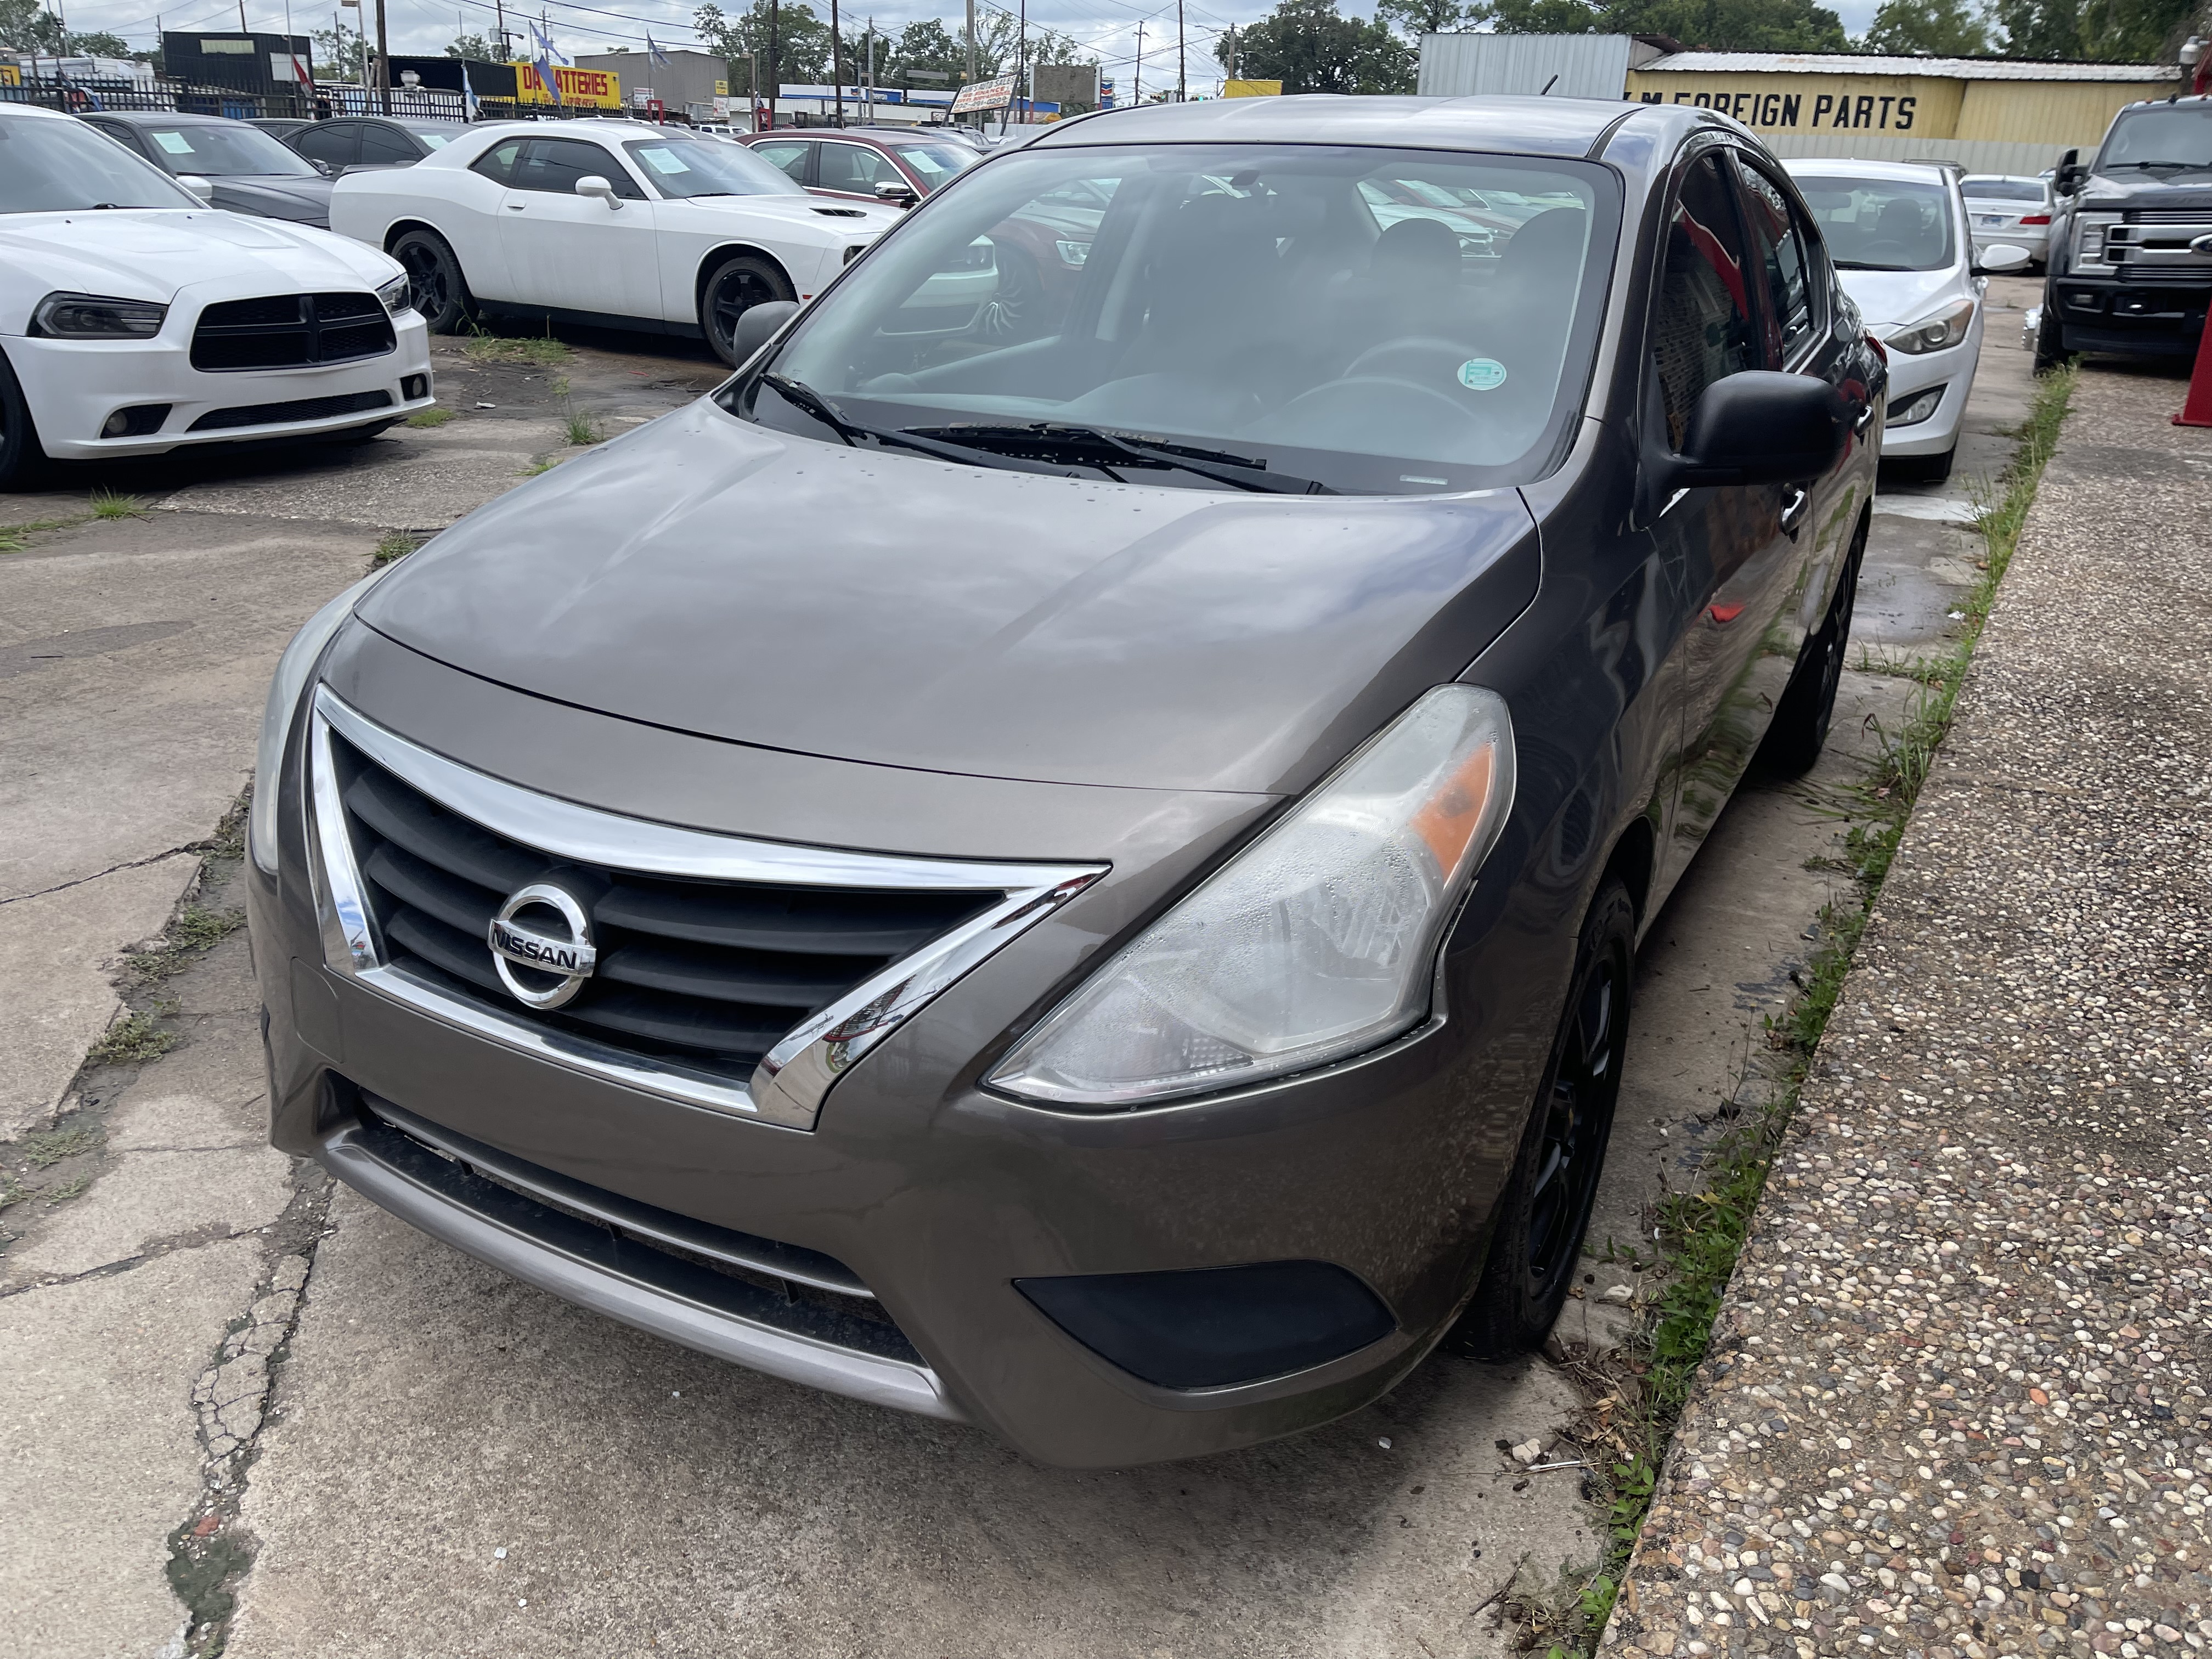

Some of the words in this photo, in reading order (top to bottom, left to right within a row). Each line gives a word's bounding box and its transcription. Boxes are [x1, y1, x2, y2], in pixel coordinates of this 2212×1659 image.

[523, 66, 542, 91] DA
[548, 69, 608, 96] ATTERIES
[975, 86, 1006, 96] FINANCE
[979, 81, 994, 90] AUTO
[996, 76, 1015, 86] SALES
[1812, 94, 1916, 129] PARTS
[492, 927, 577, 970] NISSAN
